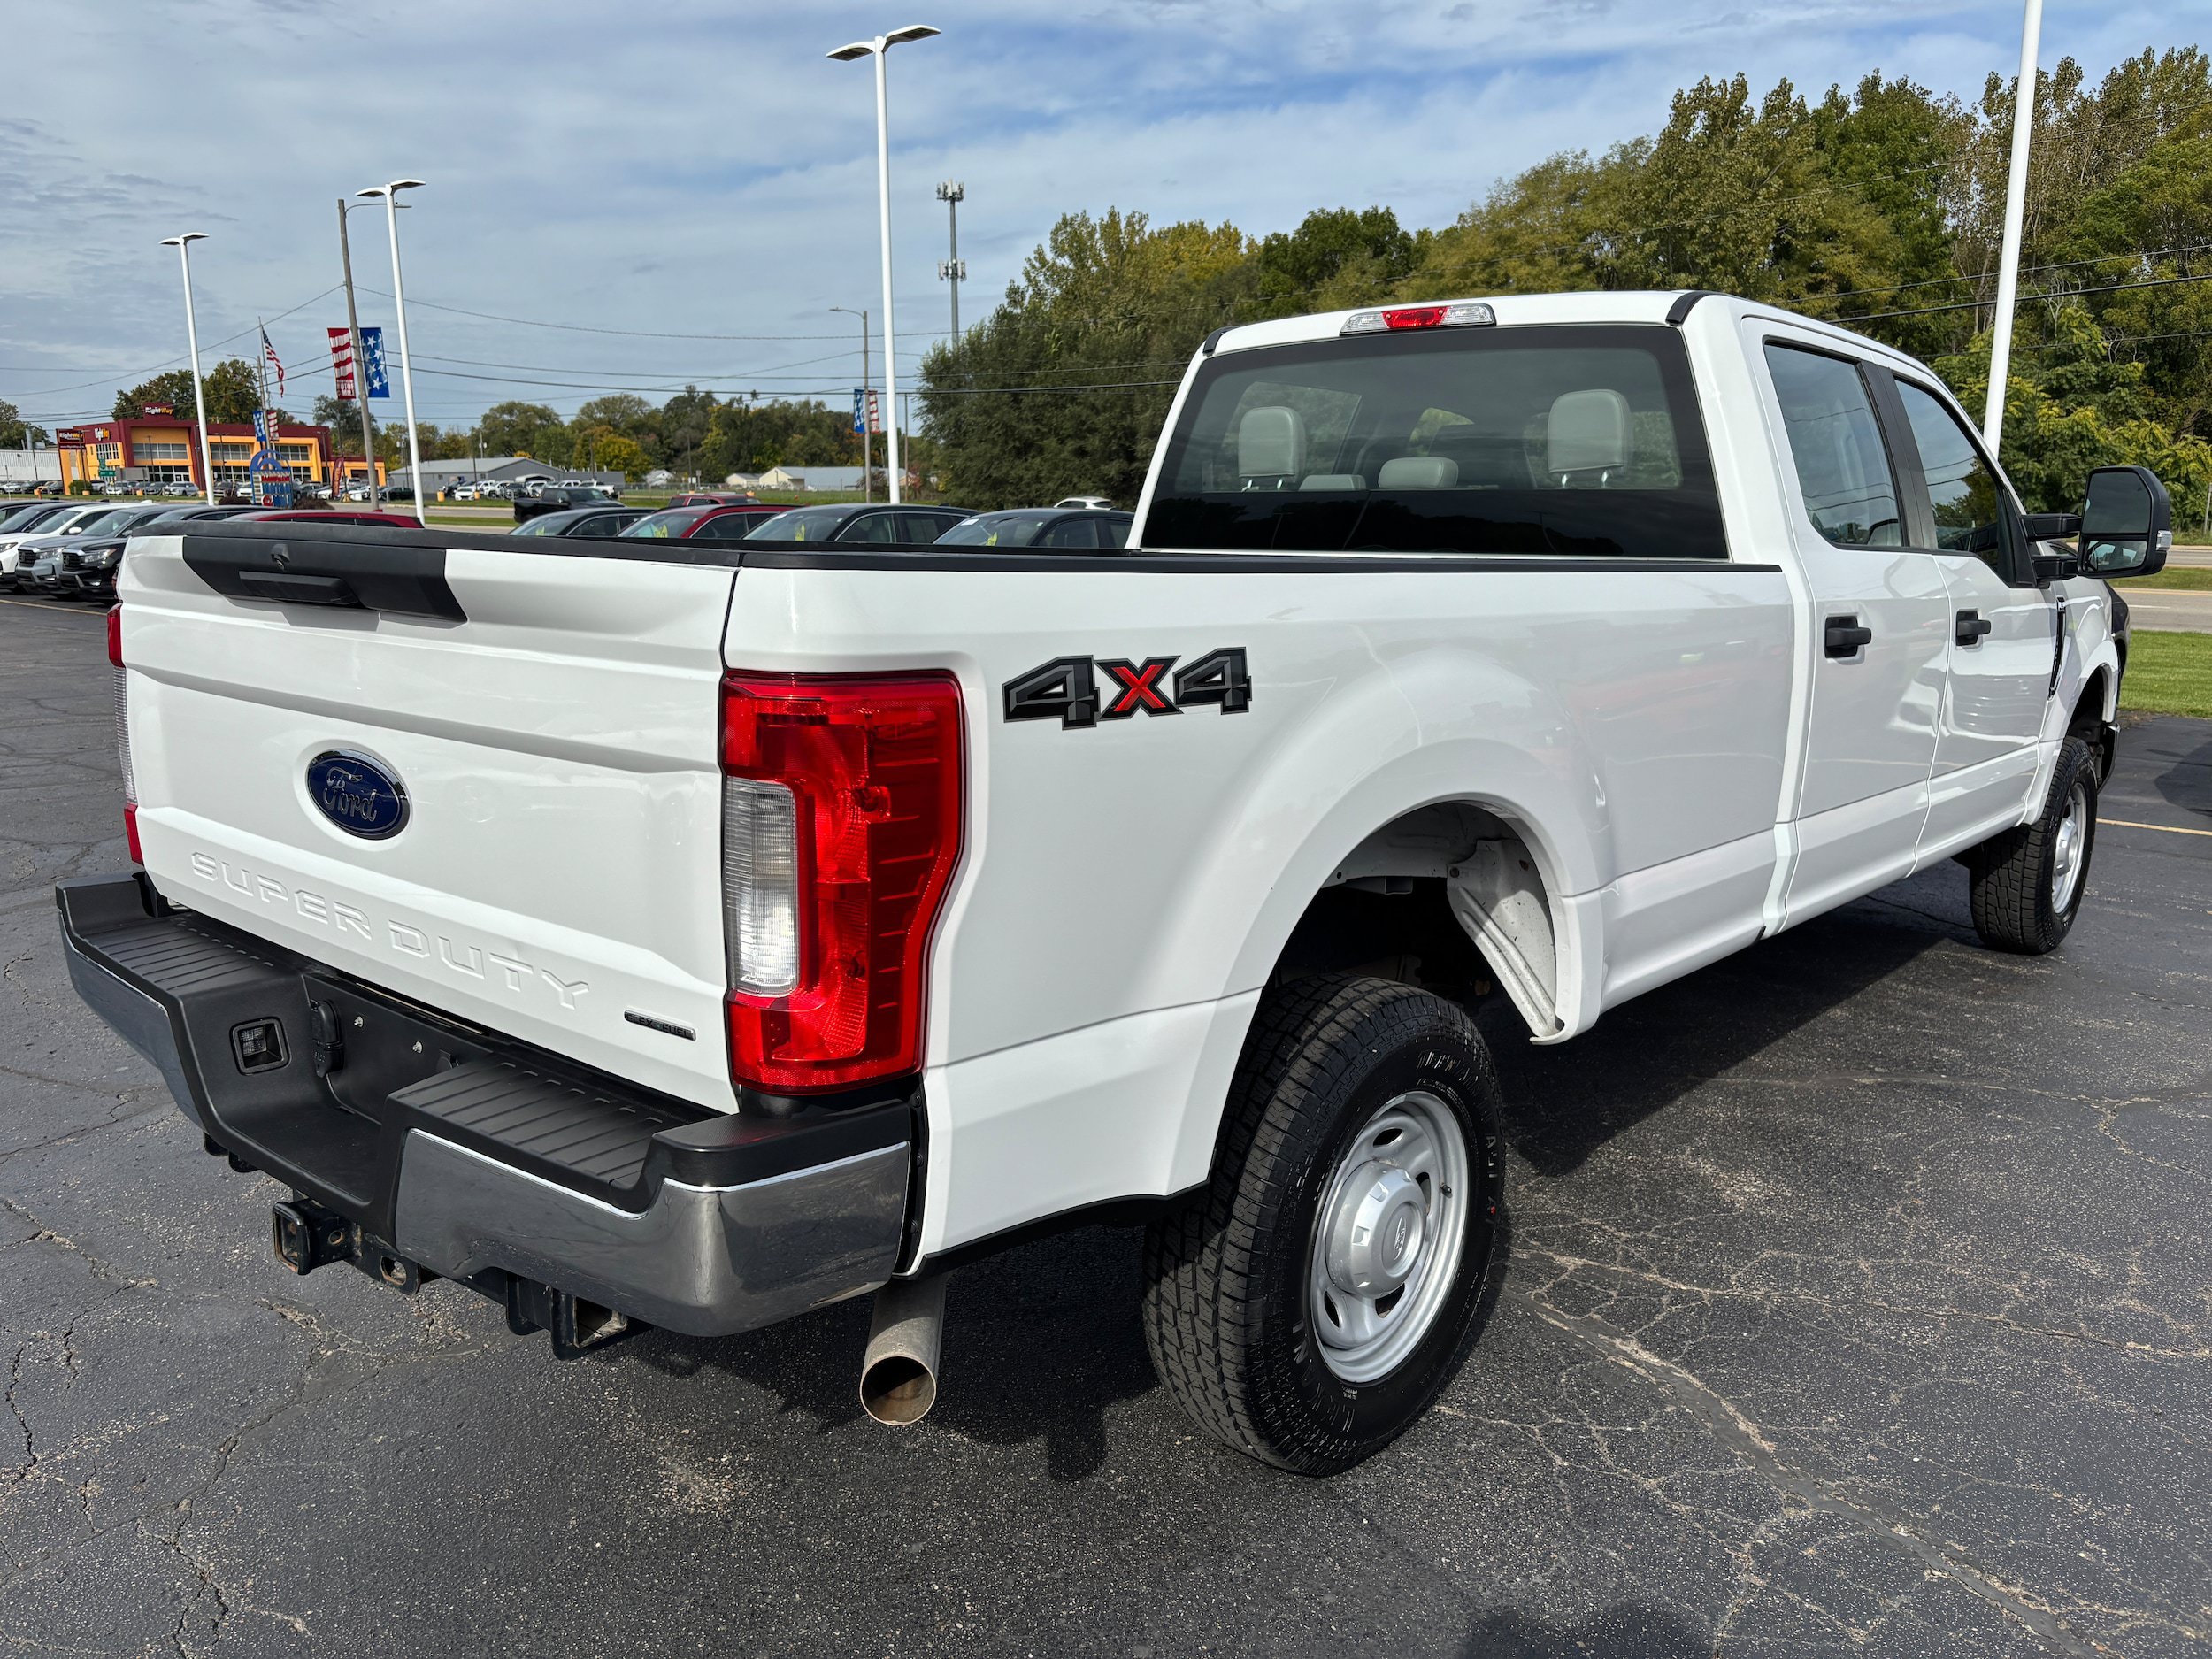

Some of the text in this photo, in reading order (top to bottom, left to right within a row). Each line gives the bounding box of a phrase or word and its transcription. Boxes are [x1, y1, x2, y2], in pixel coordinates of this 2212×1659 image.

[322, 766, 377, 822] Ford
[191, 851, 589, 1010] SUPER DUTY
